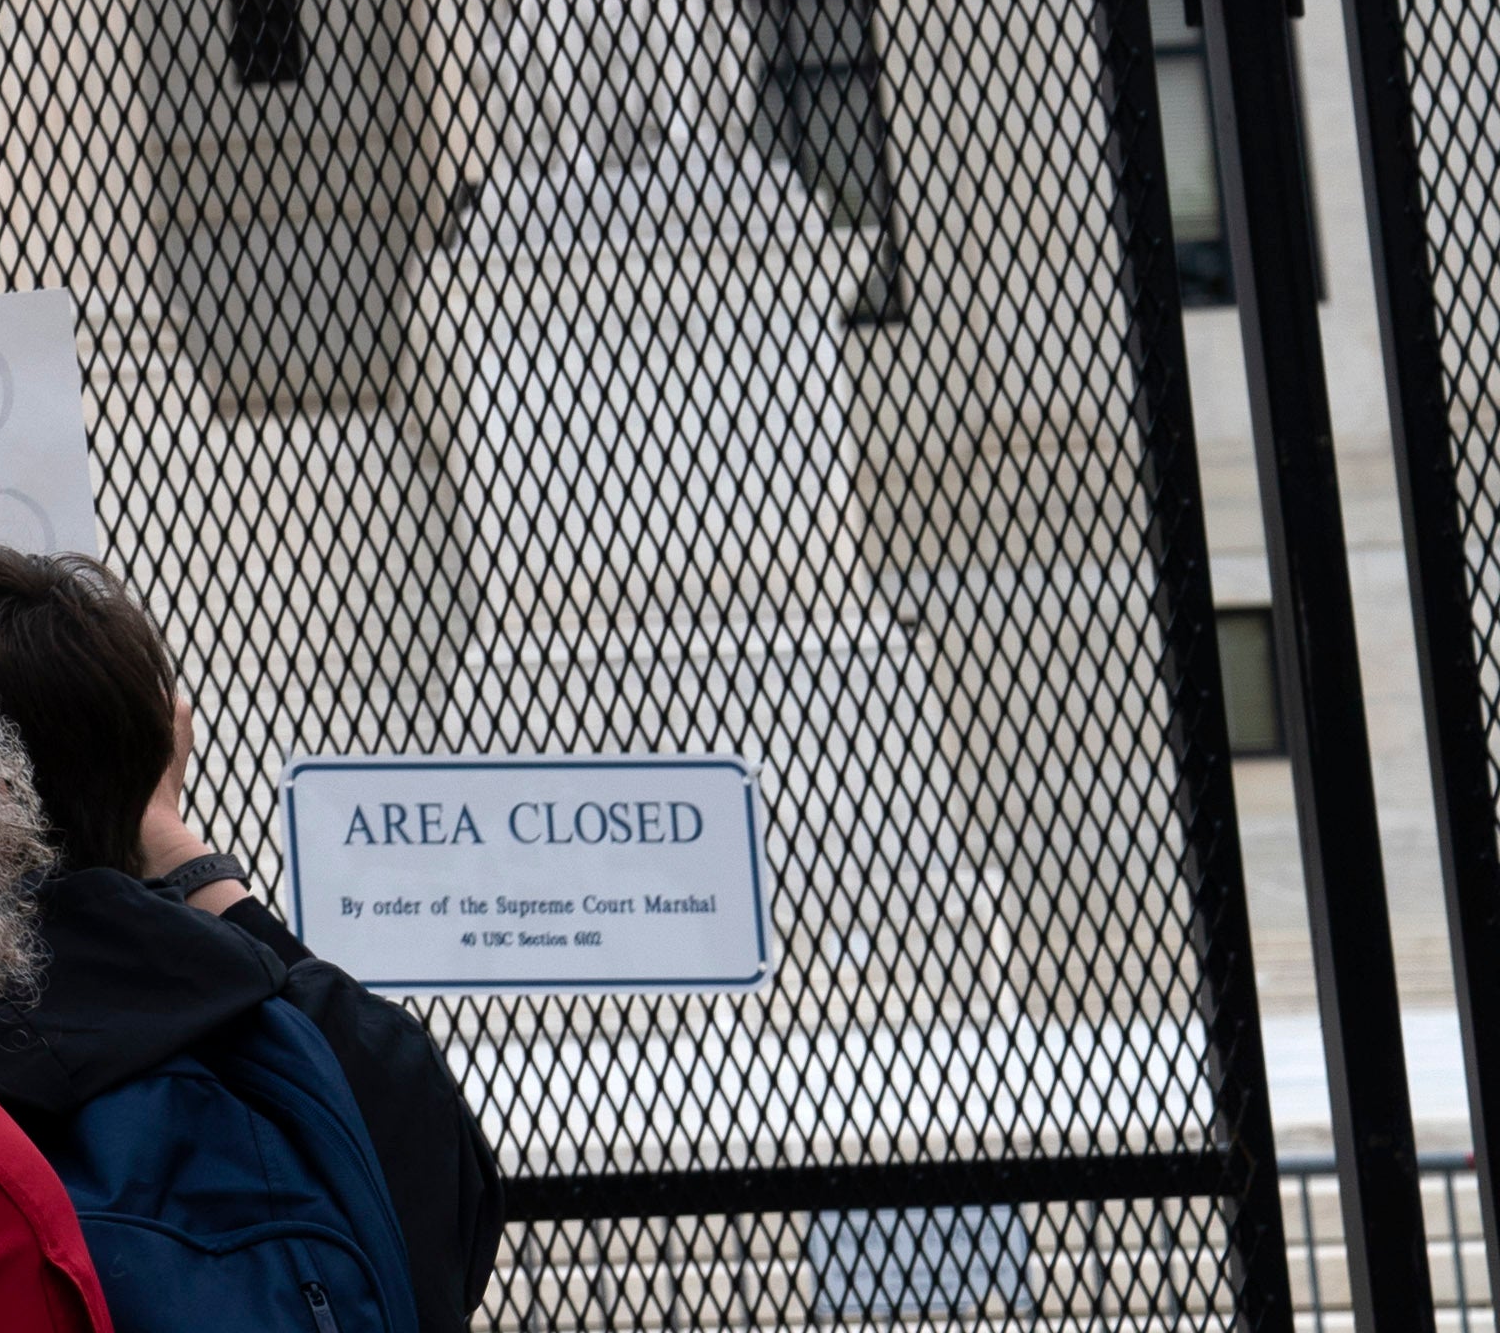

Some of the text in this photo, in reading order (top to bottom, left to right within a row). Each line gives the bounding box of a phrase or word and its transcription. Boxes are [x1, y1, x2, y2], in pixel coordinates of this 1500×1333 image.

[342, 801, 705, 847] AREA CLOSED
[340, 893, 718, 919] By order of the Supreme Court Marshal
[460, 932, 477, 947] 40
[482, 931, 513, 947] USC
[517, 931, 568, 947] Section
